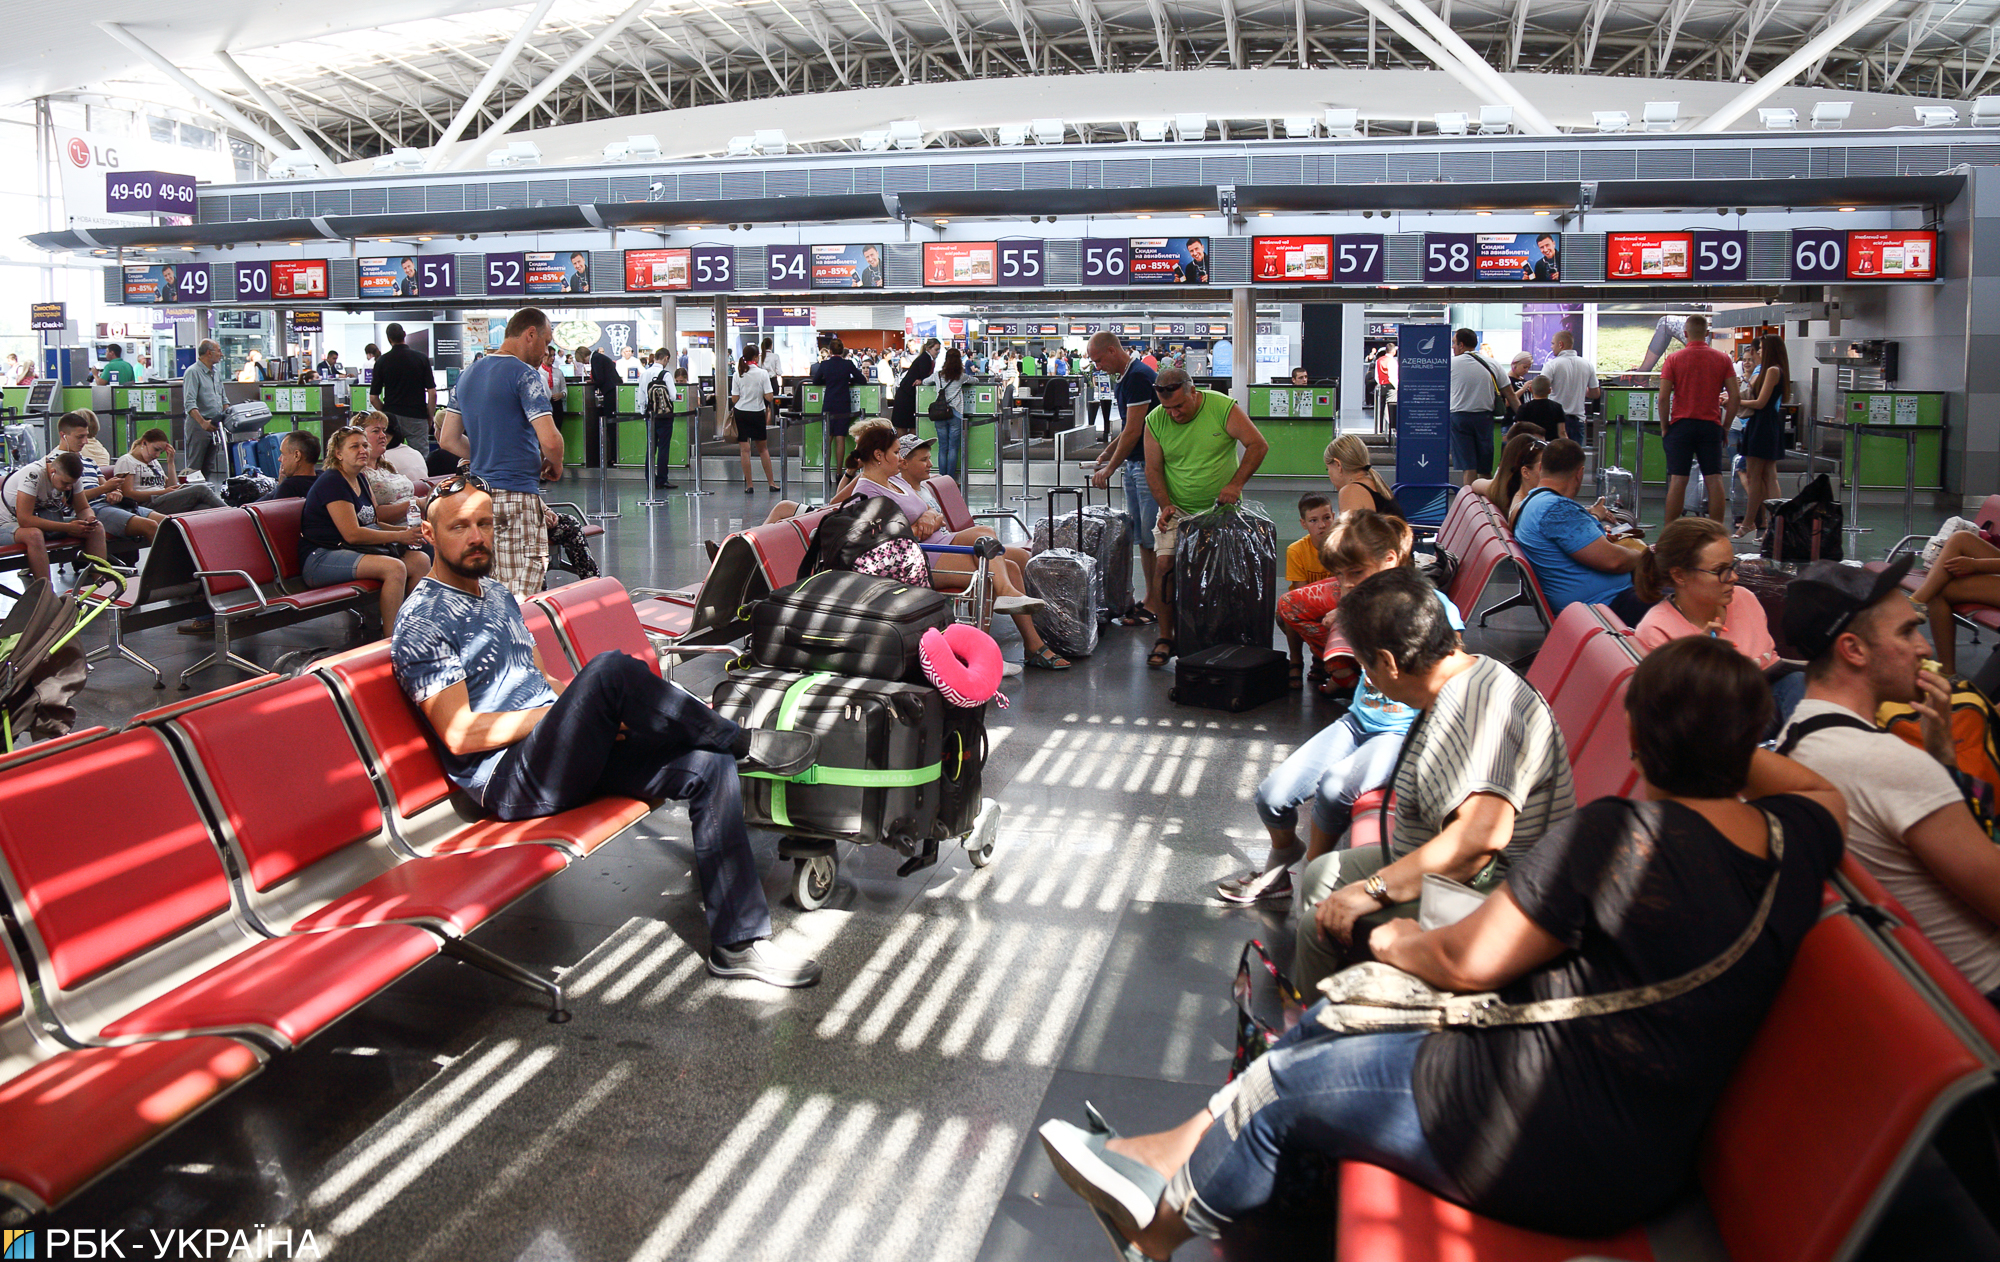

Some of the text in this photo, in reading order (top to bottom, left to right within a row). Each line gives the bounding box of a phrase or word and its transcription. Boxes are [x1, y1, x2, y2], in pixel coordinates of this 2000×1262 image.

[94, 145, 119, 168] LG
[110, 183, 152, 200] 49-60
[159, 184, 193, 202] 49-60
[1003, 249, 1039, 277] 55
[1087, 248, 1124, 276] 56
[1340, 244, 1379, 273] 57
[1428, 243, 1469, 272] 58
[1495, 258, 1519, 266] -85%
[1700, 241, 1742, 271] 59
[1796, 240, 1840, 271] 60
[424, 263, 450, 288] 51
[490, 261, 520, 286] 52
[697, 255, 730, 282] 53
[771, 254, 806, 280] 54
[1135, 263, 1147, 271] до
[180, 271, 208, 294] 49
[240, 269, 267, 293] 50
[540, 273, 558, 281] -85%
[1006, 325, 1017, 333] 25
[1027, 325, 1038, 333] 26
[1089, 325, 1099, 333] 27
[1110, 325, 1121, 333] 28
[1173, 325, 1184, 333] 29
[1196, 325, 1207, 333] 30
[1261, 325, 1271, 333] 31
[1371, 326, 1381, 334] 34
[1382, 704, 1403, 713] GIRL
[863, 774, 913, 783] CANADA
